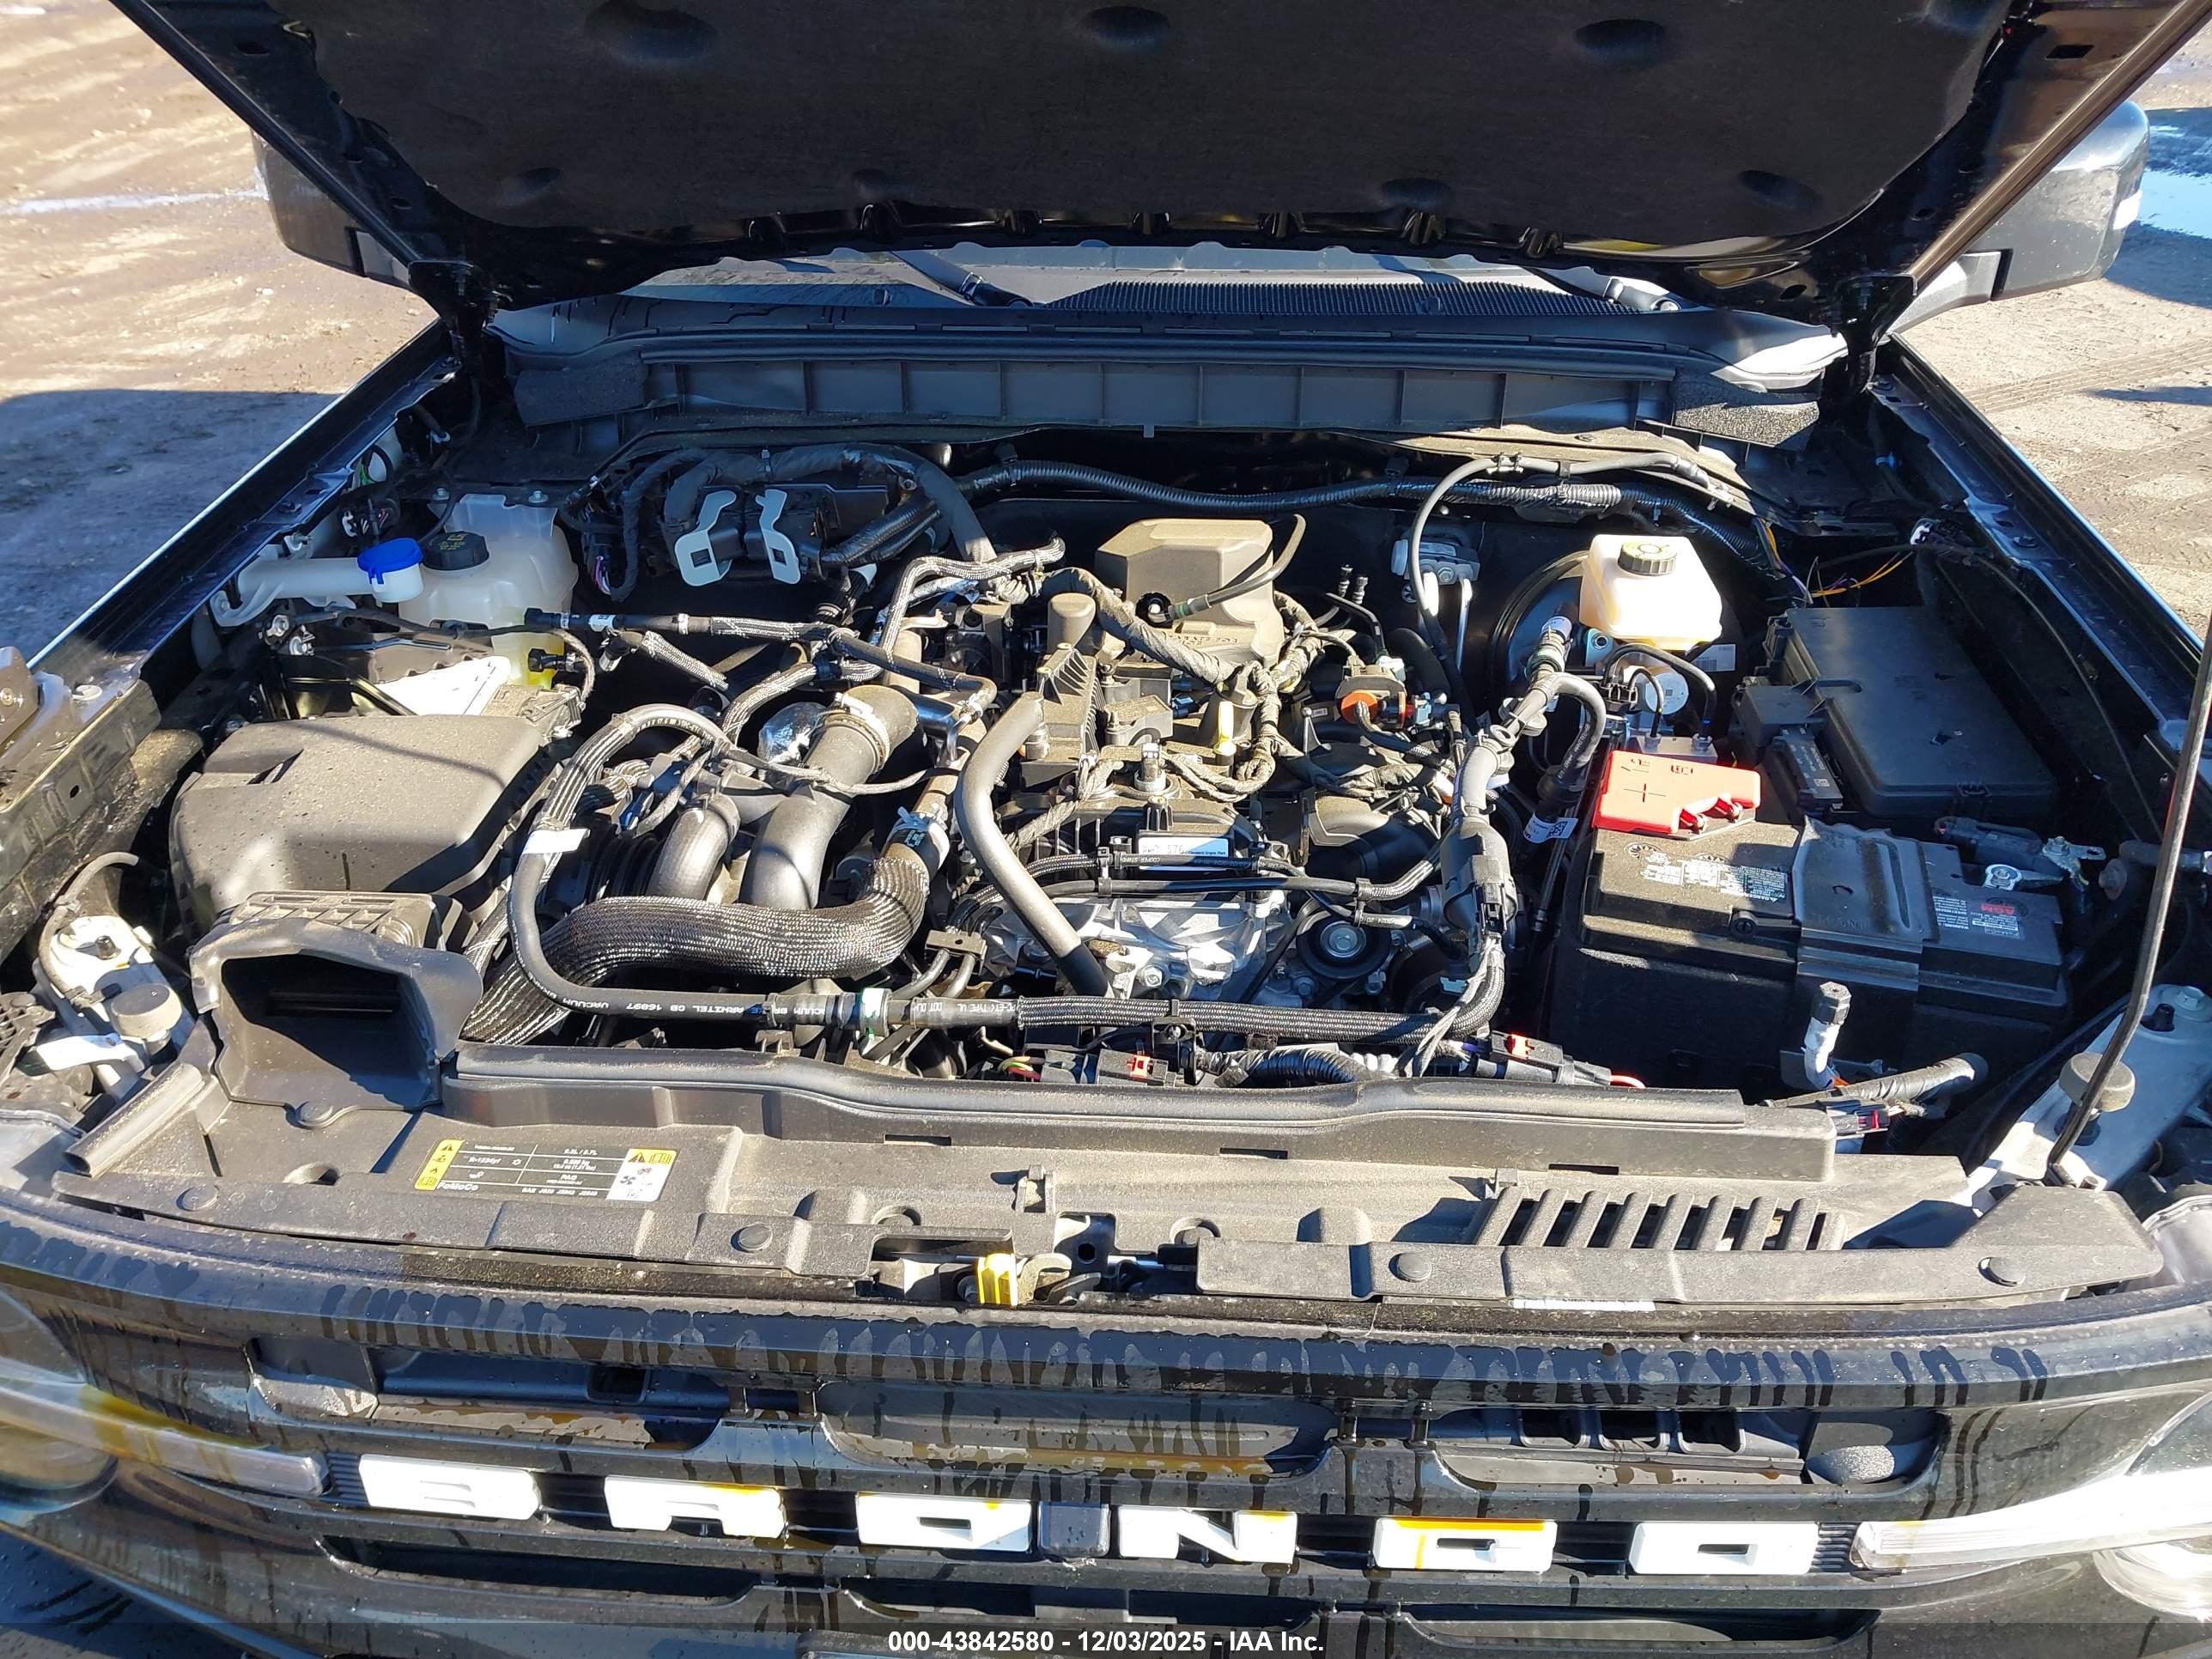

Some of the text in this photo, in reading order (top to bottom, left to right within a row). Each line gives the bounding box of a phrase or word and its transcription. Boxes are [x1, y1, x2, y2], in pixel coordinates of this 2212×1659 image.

[562, 997, 610, 1010] VACUUM
[692, 1005, 744, 1013] ARNITEL
[436, 1182, 479, 1192] FoMoCo
[358, 1454, 1819, 1575] BRONCO
